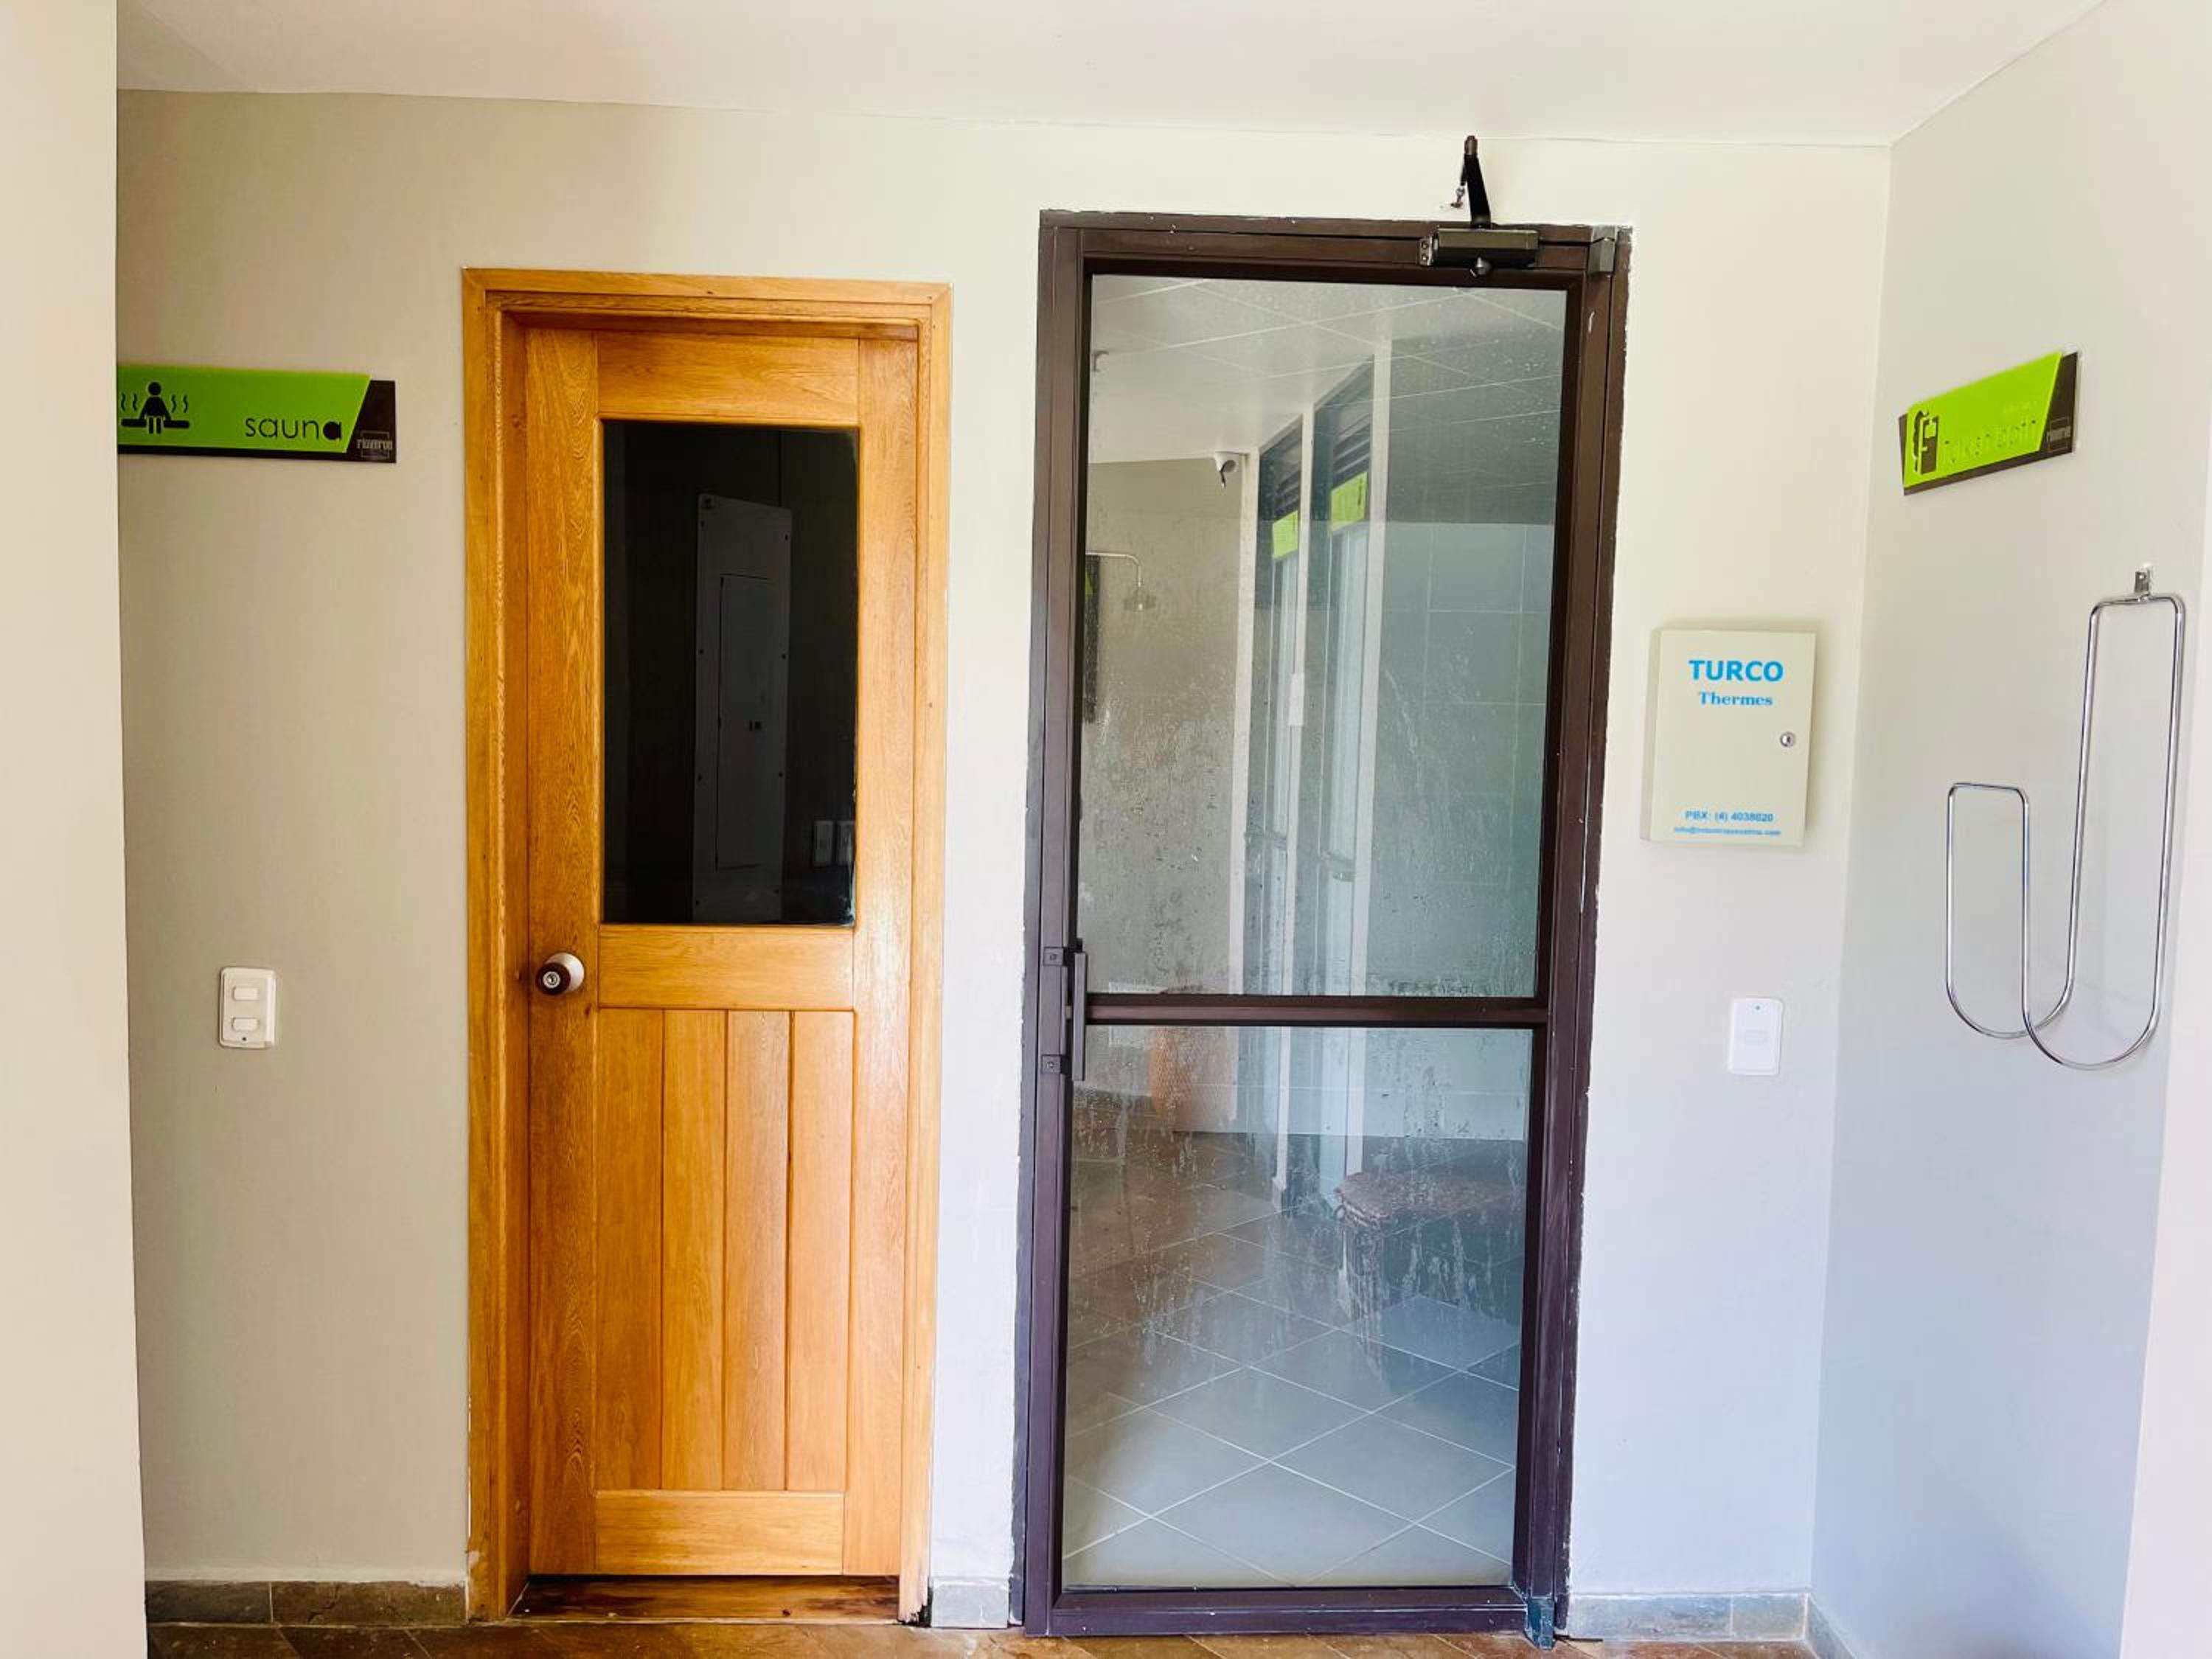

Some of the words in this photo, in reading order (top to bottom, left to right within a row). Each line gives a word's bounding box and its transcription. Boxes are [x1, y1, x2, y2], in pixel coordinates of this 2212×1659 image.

[245, 418, 342, 441] sauna
[1688, 660, 1784, 681] TURCO
[1699, 692, 1773, 706] Thermes
